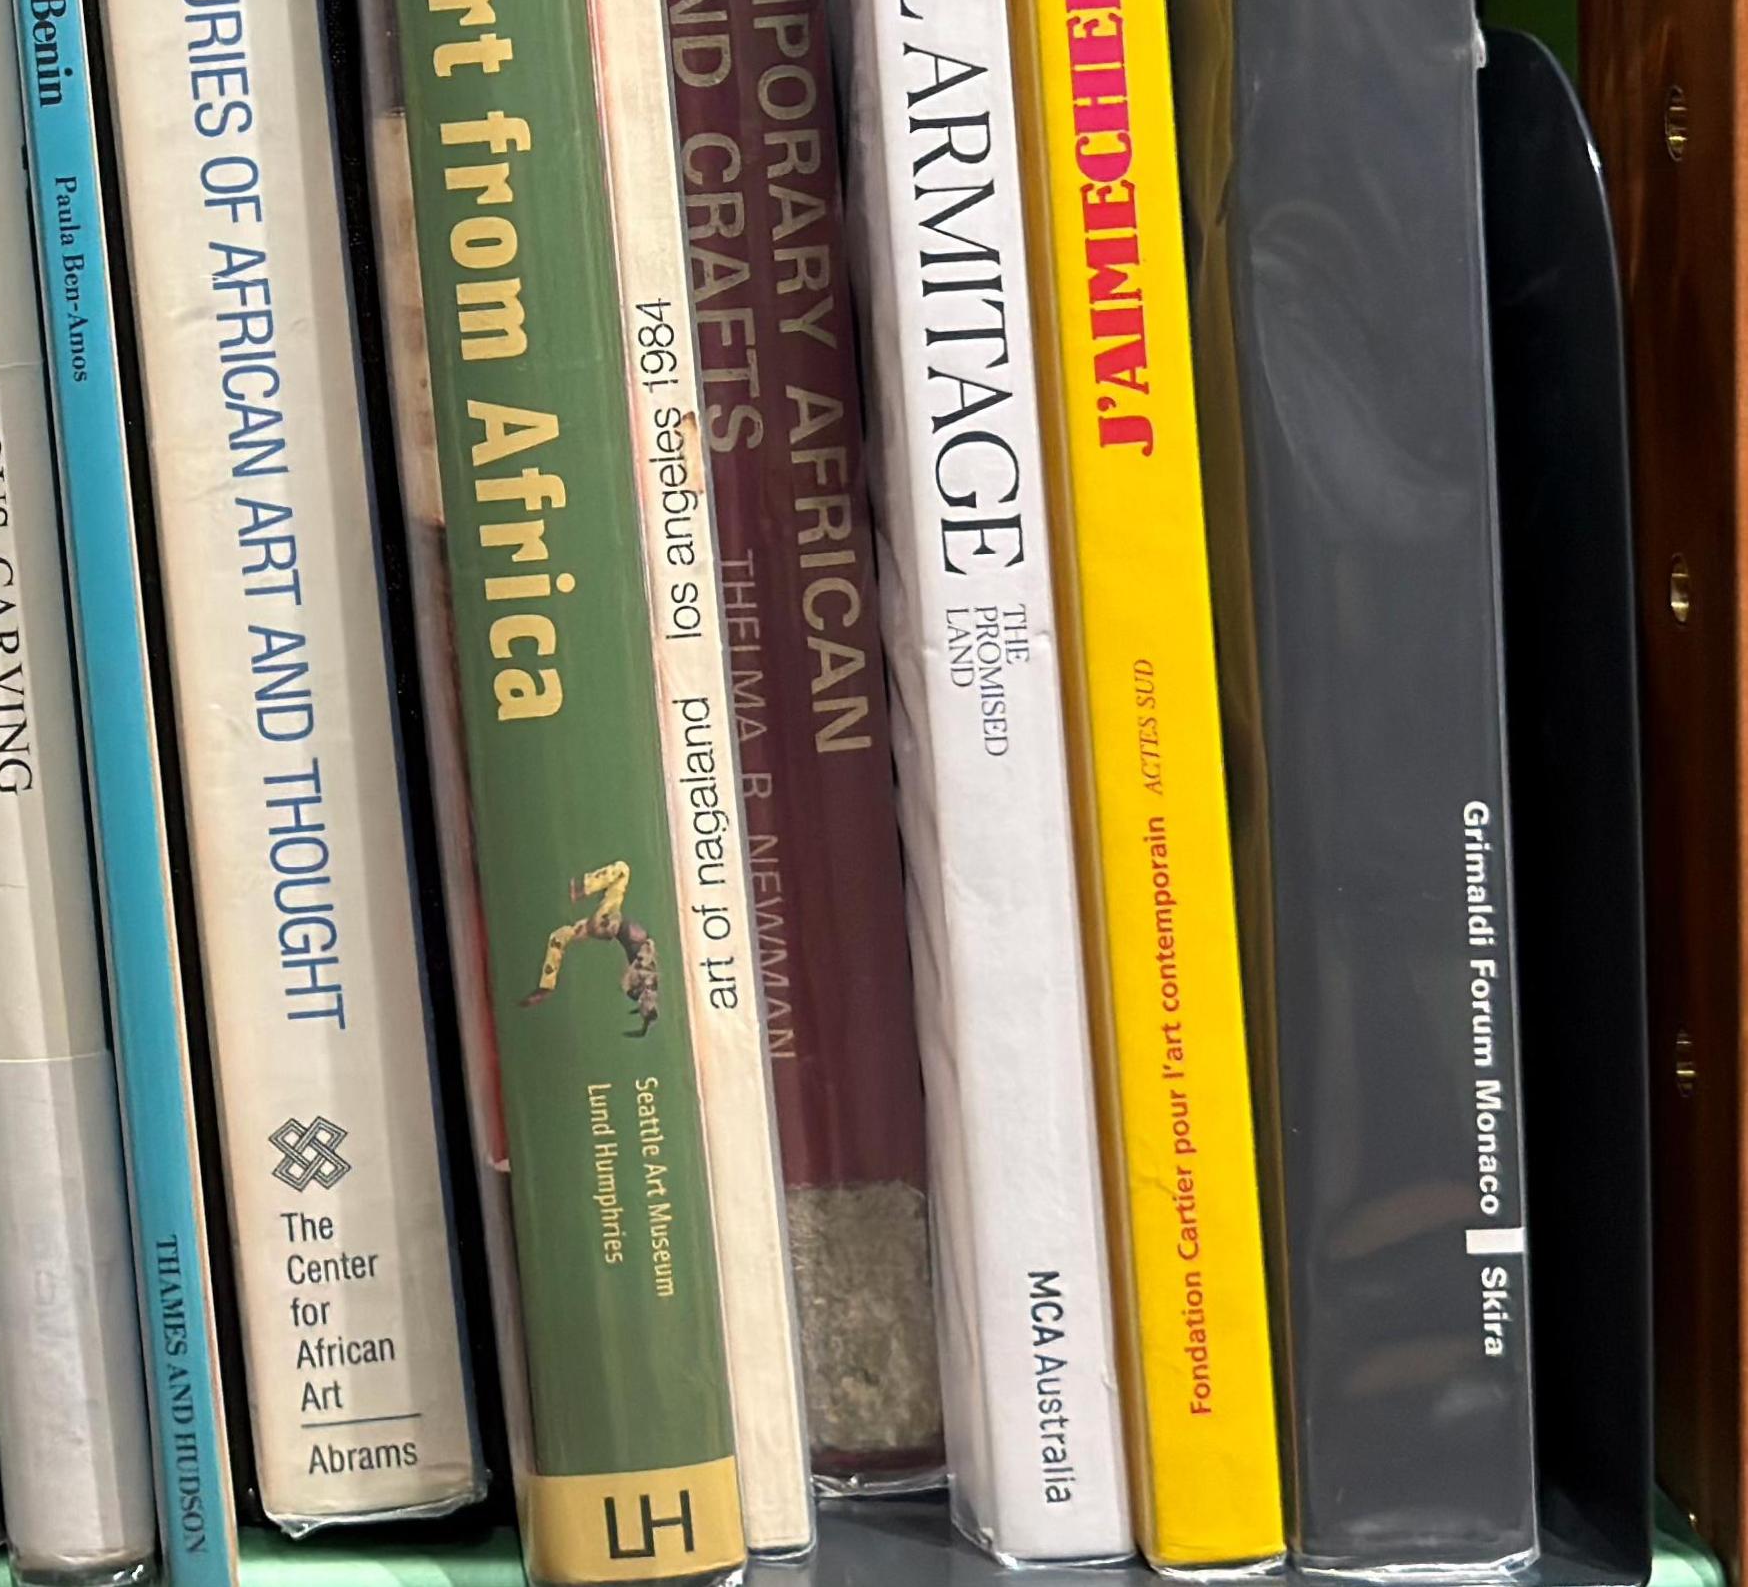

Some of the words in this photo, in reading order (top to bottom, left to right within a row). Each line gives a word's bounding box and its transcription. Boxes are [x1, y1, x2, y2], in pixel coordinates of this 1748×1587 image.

[54, 175, 79, 248] Paula
[200, 155, 263, 225] OF
[439, 109, 532, 361] from
[61, 251, 88, 384] Ben-Amos
[635, 297, 679, 394] 1984
[681, 132, 765, 454] CRAFTS
[903, 40, 1026, 577] ARMITAGE
[208, 240, 295, 479] AFRICAN
[648, 405, 704, 567] angeles
[235, 496, 303, 606] ART
[466, 398, 577, 722] Africa
[785, 384, 873, 756] AFRICAN
[665, 581, 703, 641] los
[945, 607, 975, 689] LAND
[1002, 603, 1031, 666] THE
[248, 624, 316, 744] AND
[974, 605, 1010, 760] PROMISED
[1132, 657, 1157, 712] SUD
[672, 696, 730, 886] nagaland
[1139, 718, 1164, 796] ACTES
[263, 756, 348, 1031] THOUGHT
[692, 905, 732, 941] of
[1142, 815, 1181, 1014] contemporain
[1462, 799, 1496, 948] Grimaldi
[699, 956, 739, 1011] art
[1468, 957, 1496, 1069] Forum
[1160, 1019, 1186, 1081] l'art
[1171, 1094, 1198, 1157] pour
[1475, 1079, 1504, 1217] Monaco
[1175, 1162, 1200, 1262] Cartier
[1027, 1268, 1064, 1346] MCA
[1188, 1270, 1215, 1416] Fondation
[1479, 1265, 1508, 1358] Skira
[1032, 1351, 1074, 1506] Australia
